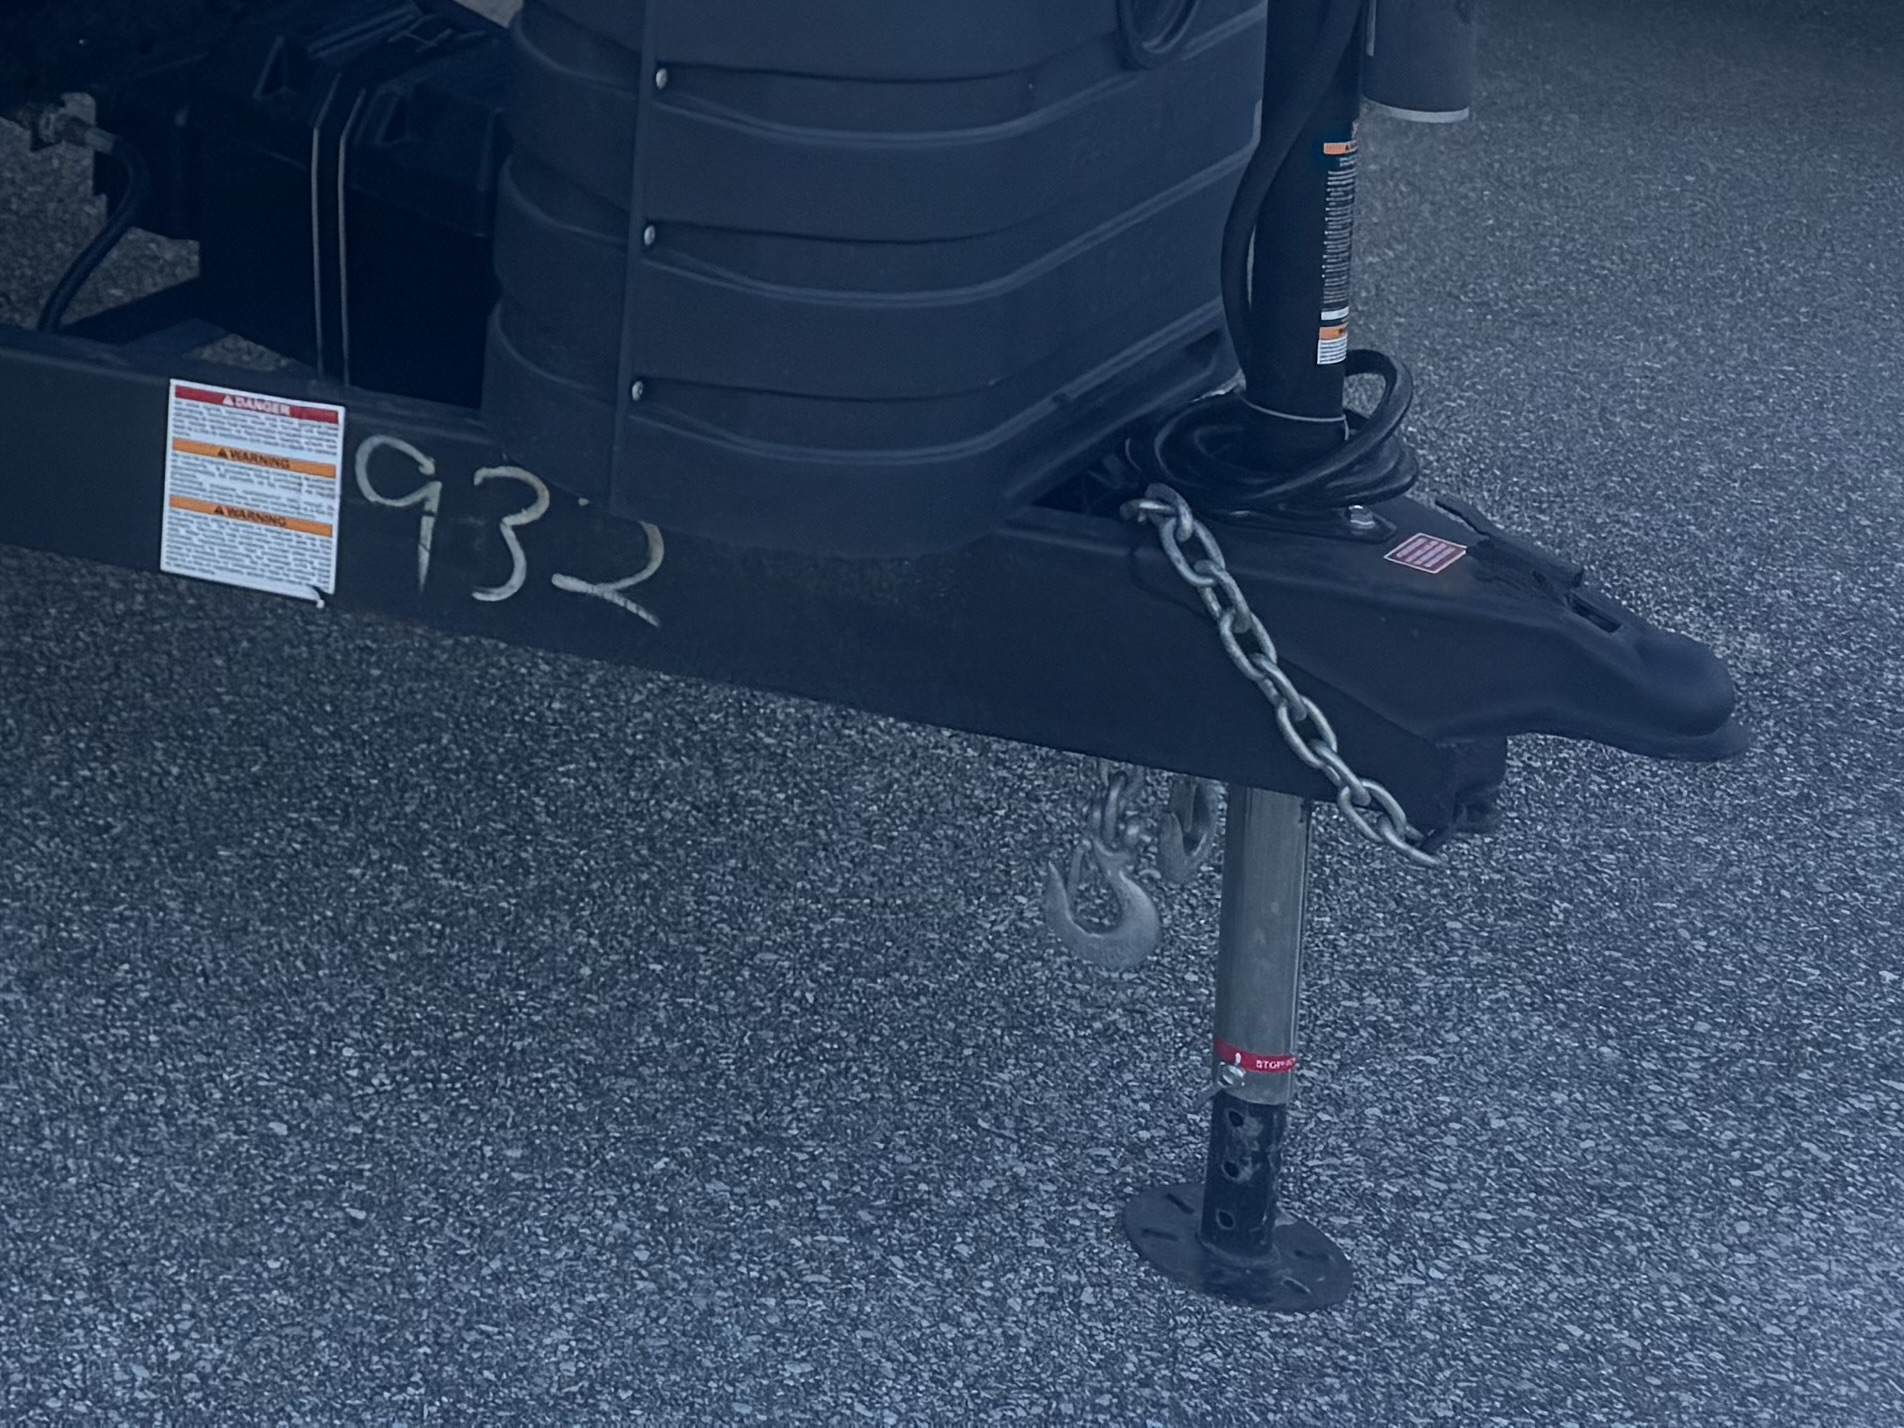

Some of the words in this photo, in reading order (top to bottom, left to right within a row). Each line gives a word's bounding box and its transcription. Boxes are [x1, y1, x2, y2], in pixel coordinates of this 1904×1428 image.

[235, 396, 290, 416] DANGER
[231, 448, 290, 470] WARNING
[226, 506, 287, 527] WARNING
[355, 434, 665, 627] 932
